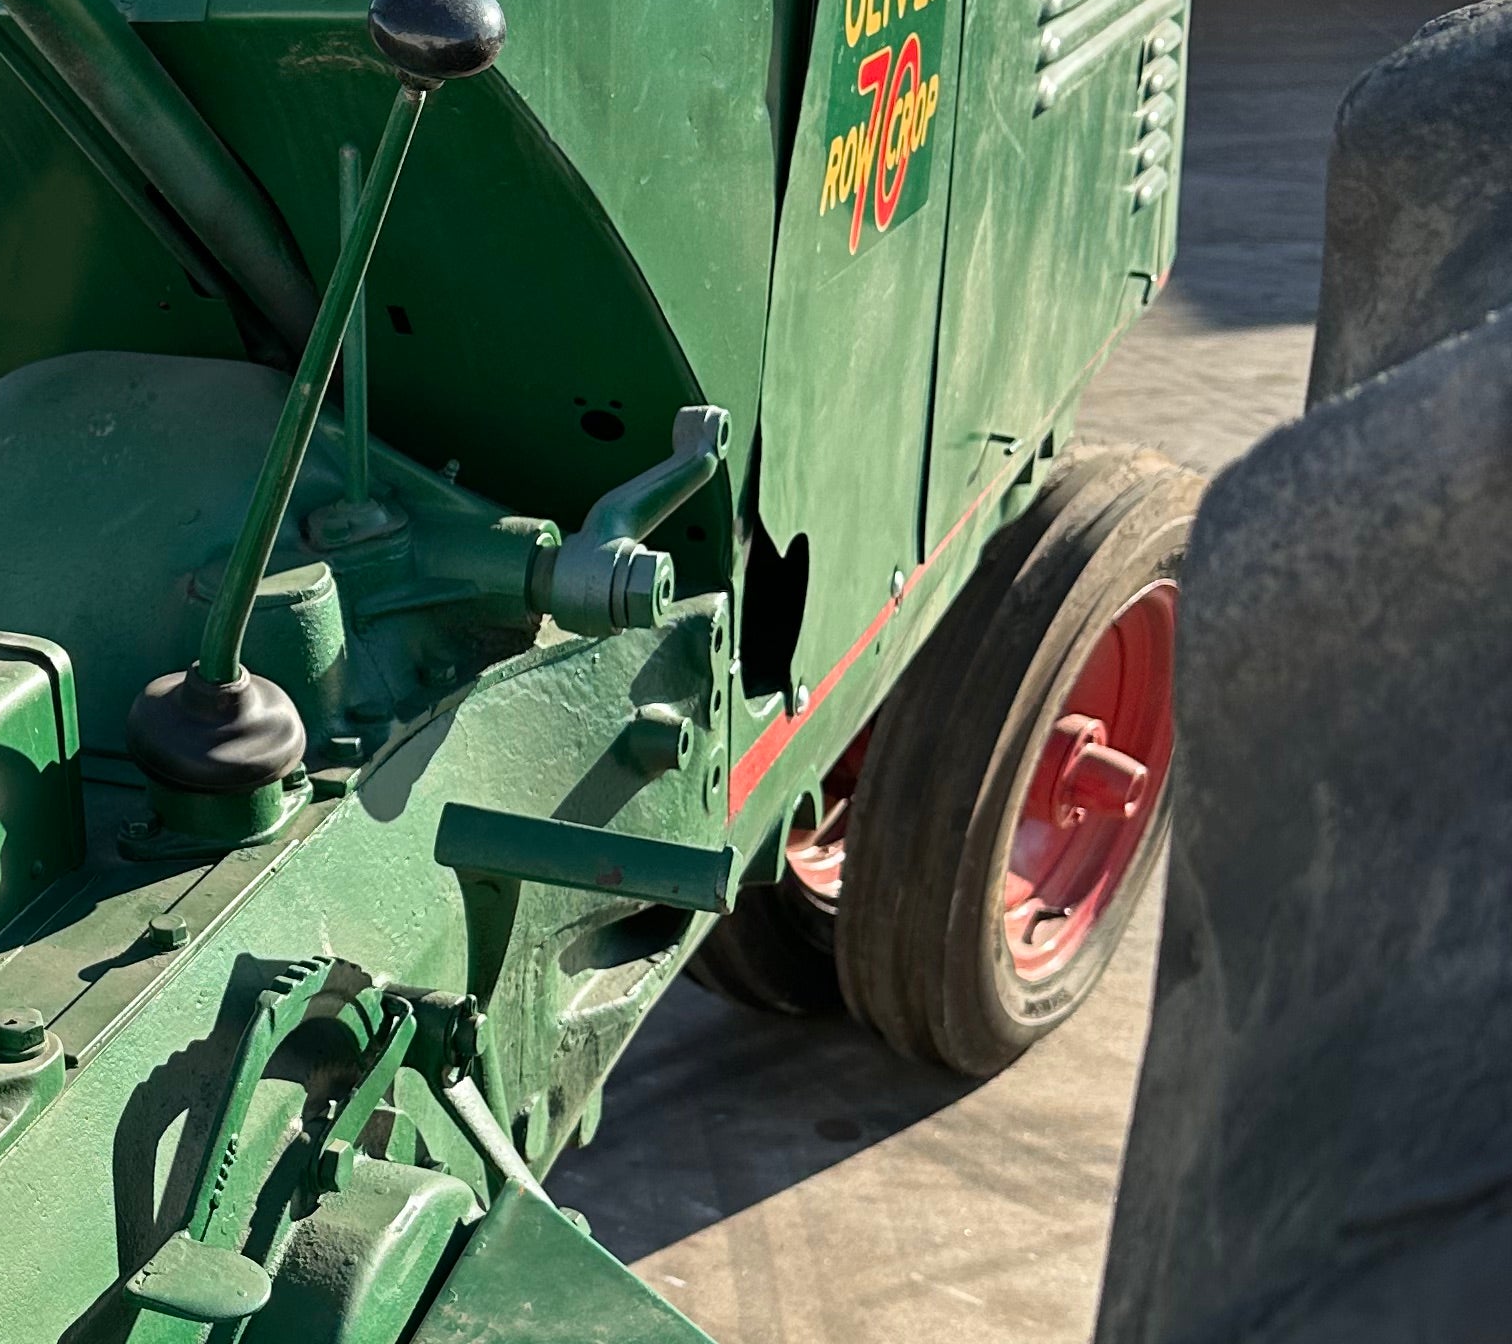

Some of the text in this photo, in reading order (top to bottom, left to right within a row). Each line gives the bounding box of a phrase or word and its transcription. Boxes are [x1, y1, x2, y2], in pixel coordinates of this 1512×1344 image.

[820, 73, 940, 216] ROW CROP
[849, 32, 922, 256] 70
